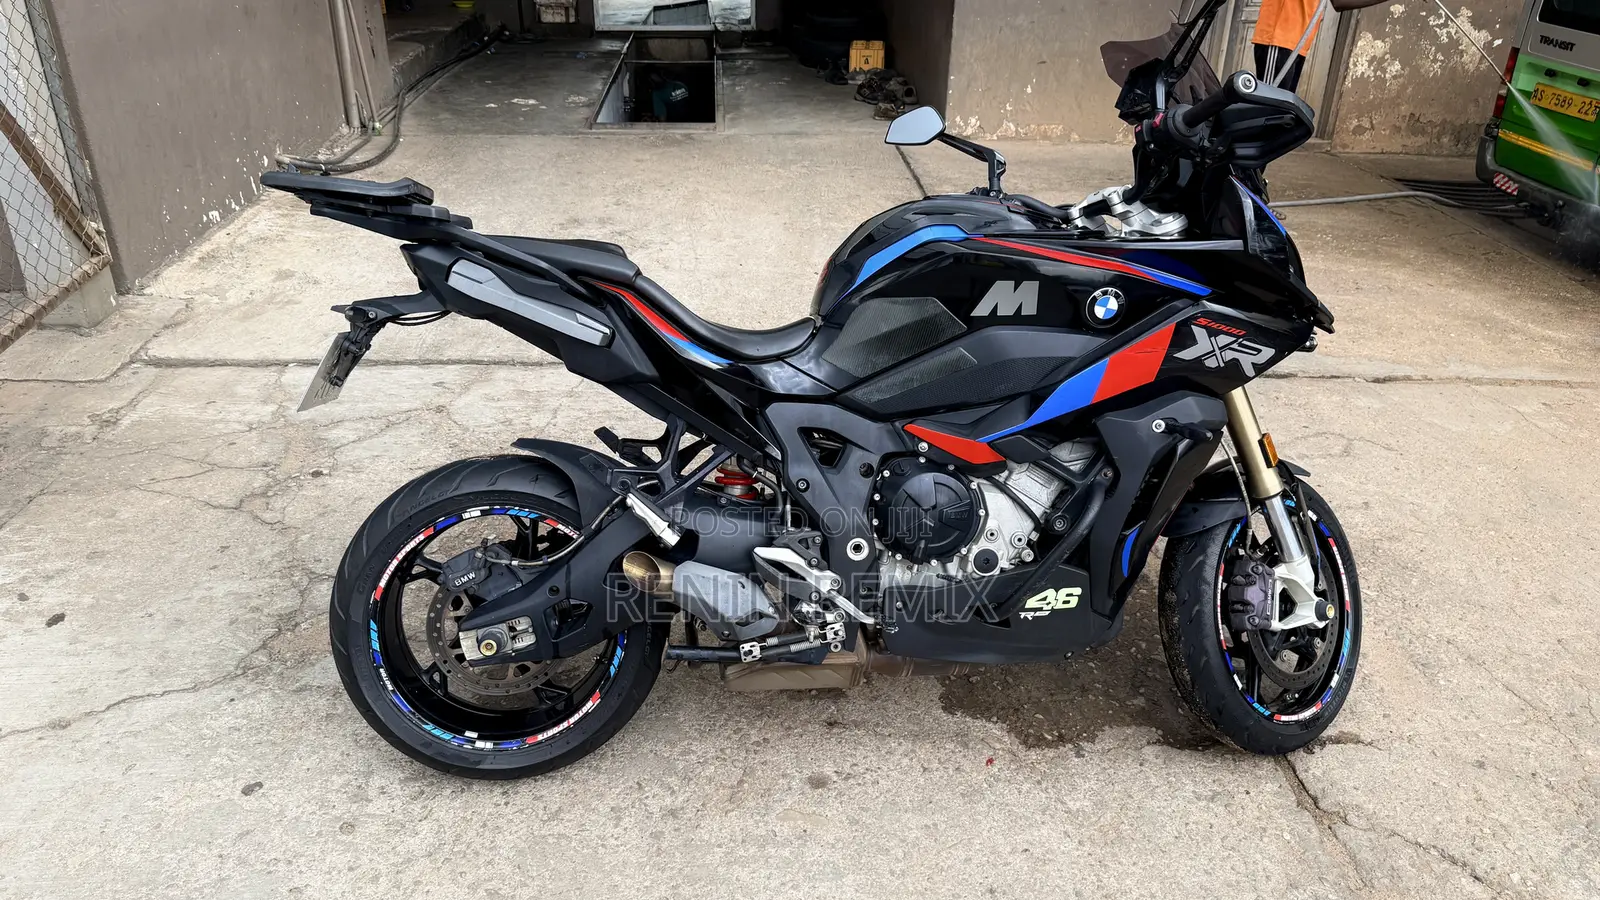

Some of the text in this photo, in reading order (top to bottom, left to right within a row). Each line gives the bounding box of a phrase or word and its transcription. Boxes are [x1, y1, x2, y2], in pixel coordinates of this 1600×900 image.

[1539, 34, 1576, 52] TRANSIT
[970, 280, 1040, 317] M
[1194, 317, 1247, 336] S1000
[1172, 325, 1276, 378] XR
[454, 571, 476, 587] BMW
[1024, 587, 1083, 611] 46
[380, 668, 393, 690] MOTOR
